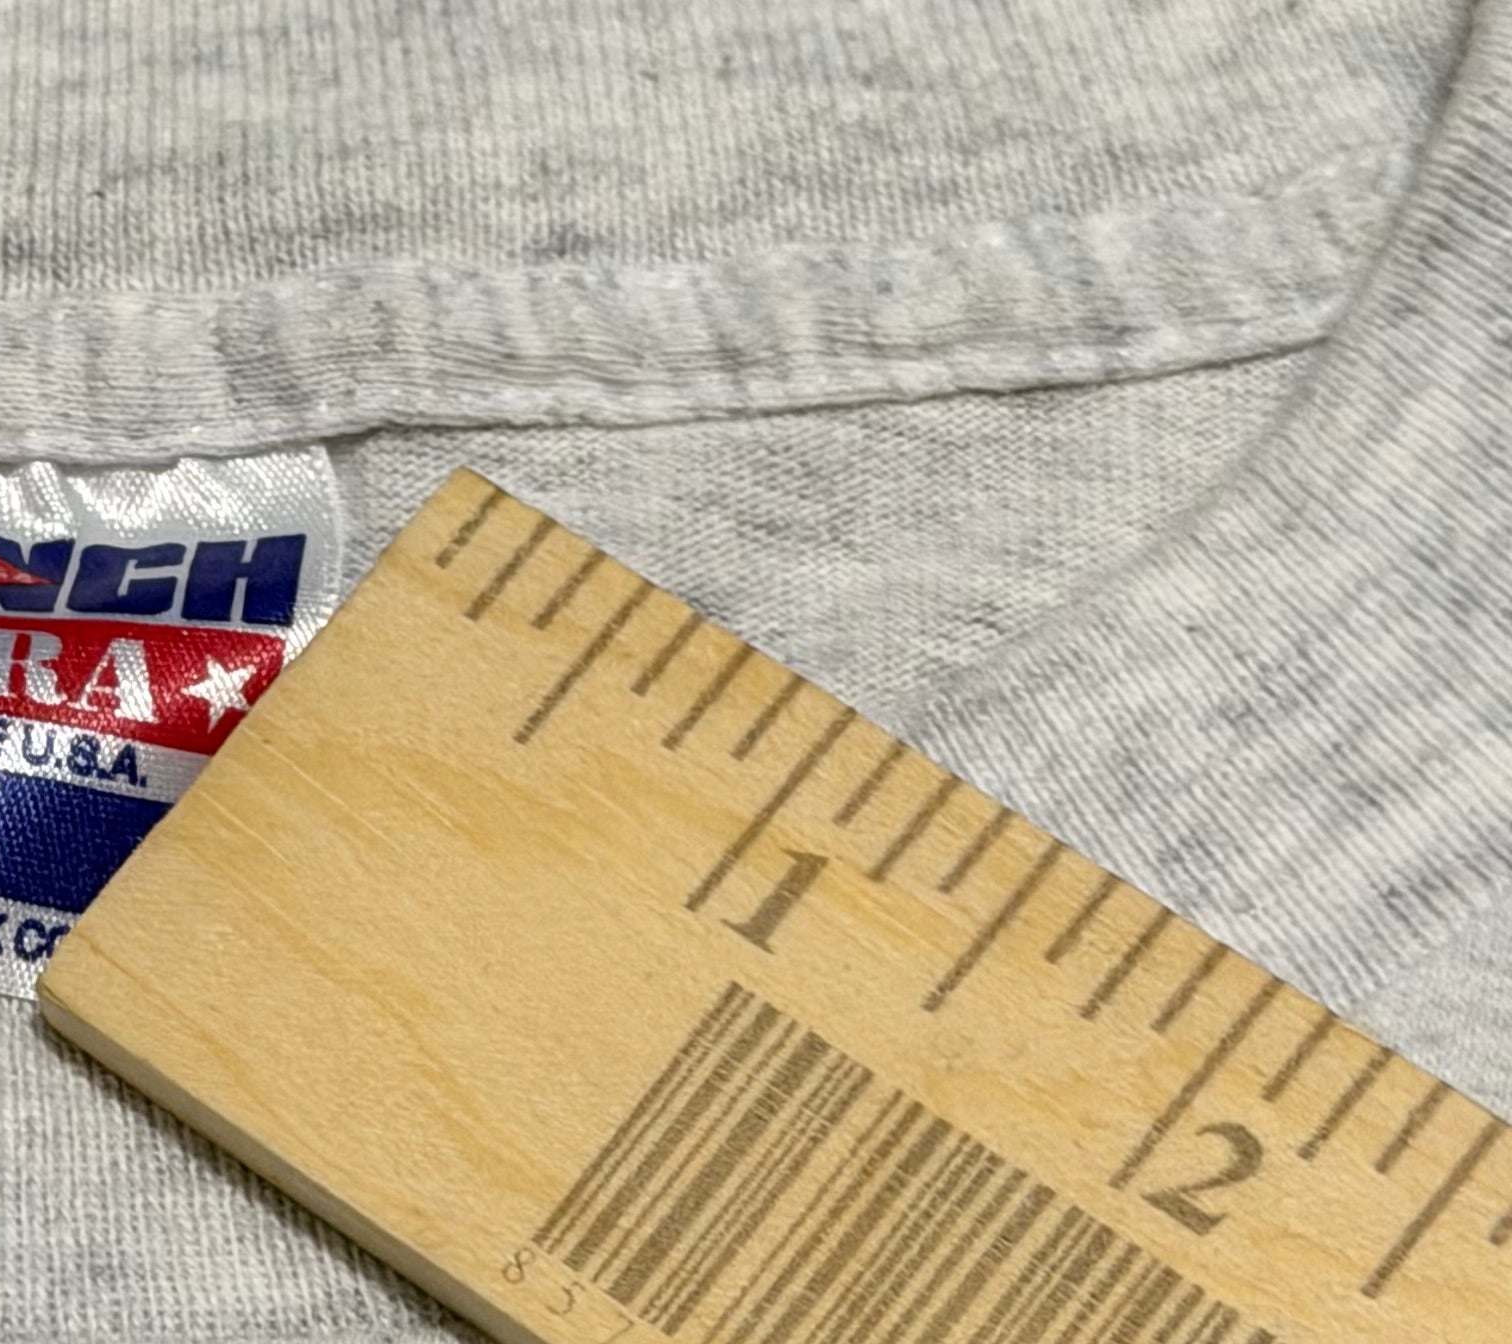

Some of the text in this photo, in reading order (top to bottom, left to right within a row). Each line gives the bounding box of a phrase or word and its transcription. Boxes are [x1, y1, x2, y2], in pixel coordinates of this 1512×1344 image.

[22, 723, 148, 788] U.S.A.
[721, 847, 831, 955] 1
[1140, 1120, 1265, 1237] 2
